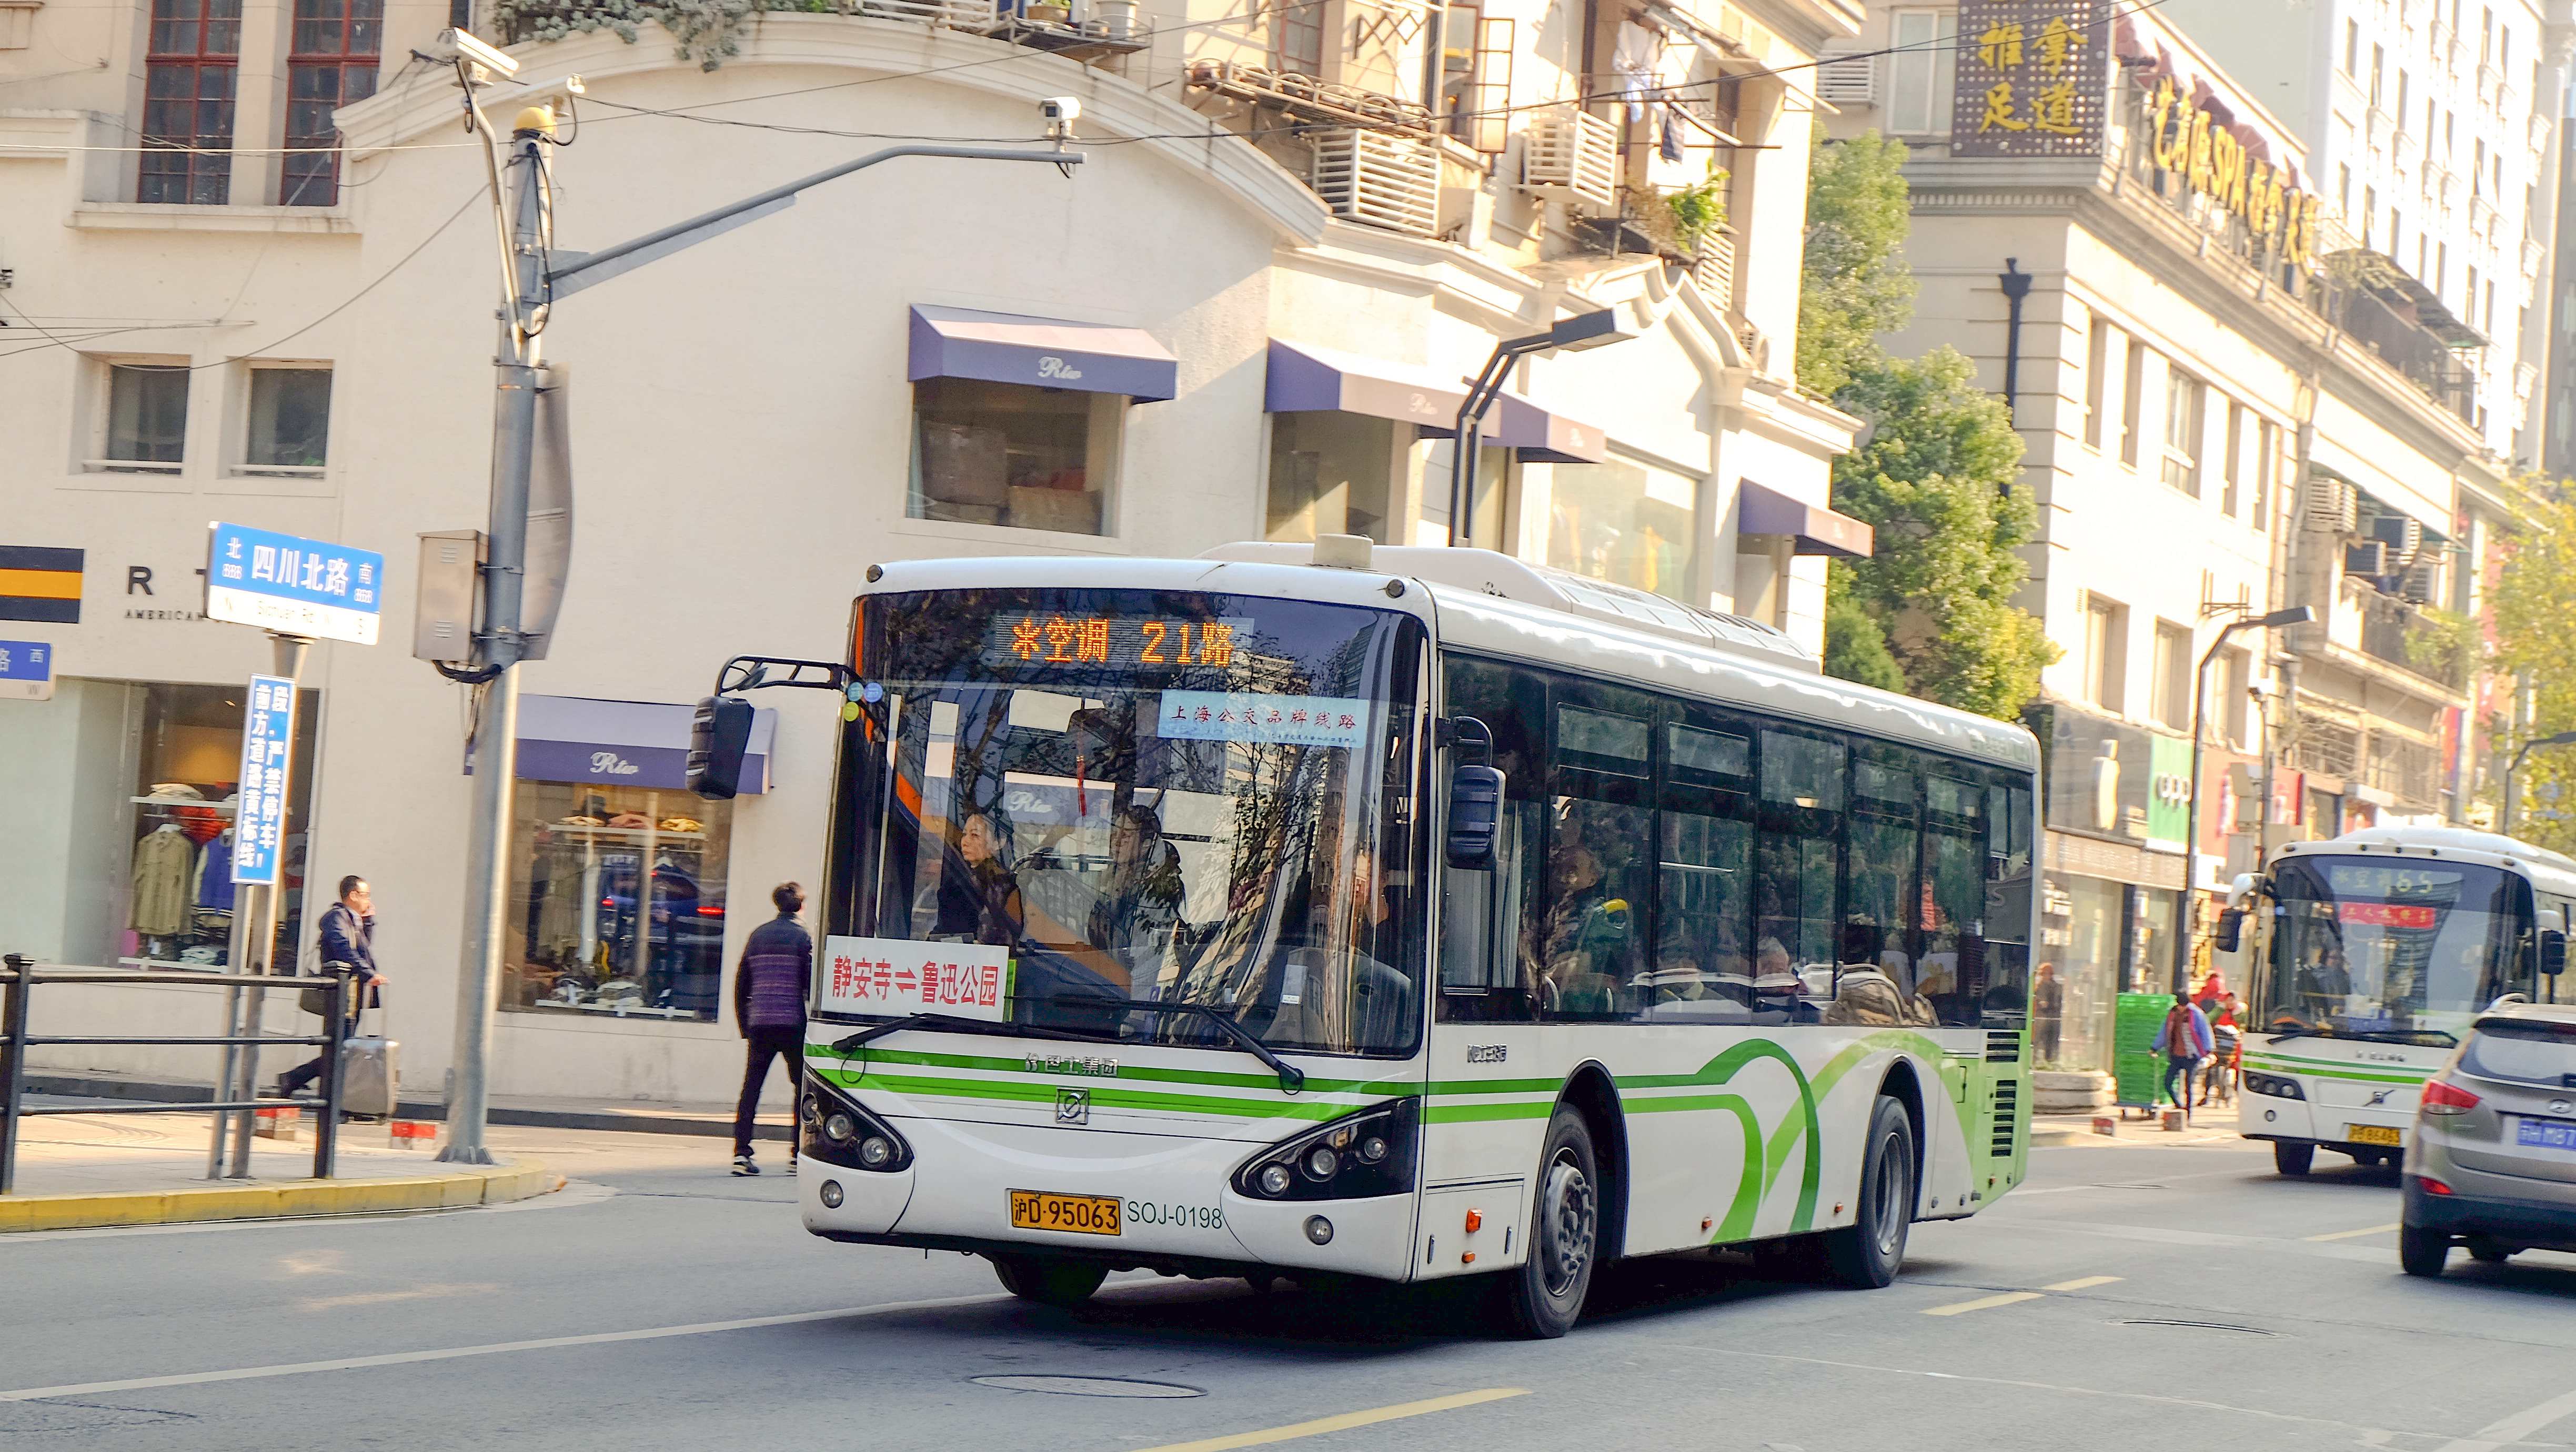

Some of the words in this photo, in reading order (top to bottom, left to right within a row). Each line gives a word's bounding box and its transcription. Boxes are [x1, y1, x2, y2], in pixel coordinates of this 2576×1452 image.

[1978, 17, 2088, 77] 推拿
[1978, 80, 2086, 135] 足道
[226, 537, 242, 559] 北
[251, 544, 349, 597] 四川北路
[358, 562, 373, 585] 南
[29, 648, 45, 664] 西
[1044, 614, 1108, 663] 空调
[1141, 621, 1234, 668] 21路
[1171, 704, 1357, 730] 上海公交品牌线路
[832, 955, 892, 1001] 静安寺
[920, 961, 999, 1007] 鲁迅公园
[1044, 1054, 1120, 1077] 巴士集团
[1127, 1200, 1223, 1230] SOJ-0198
